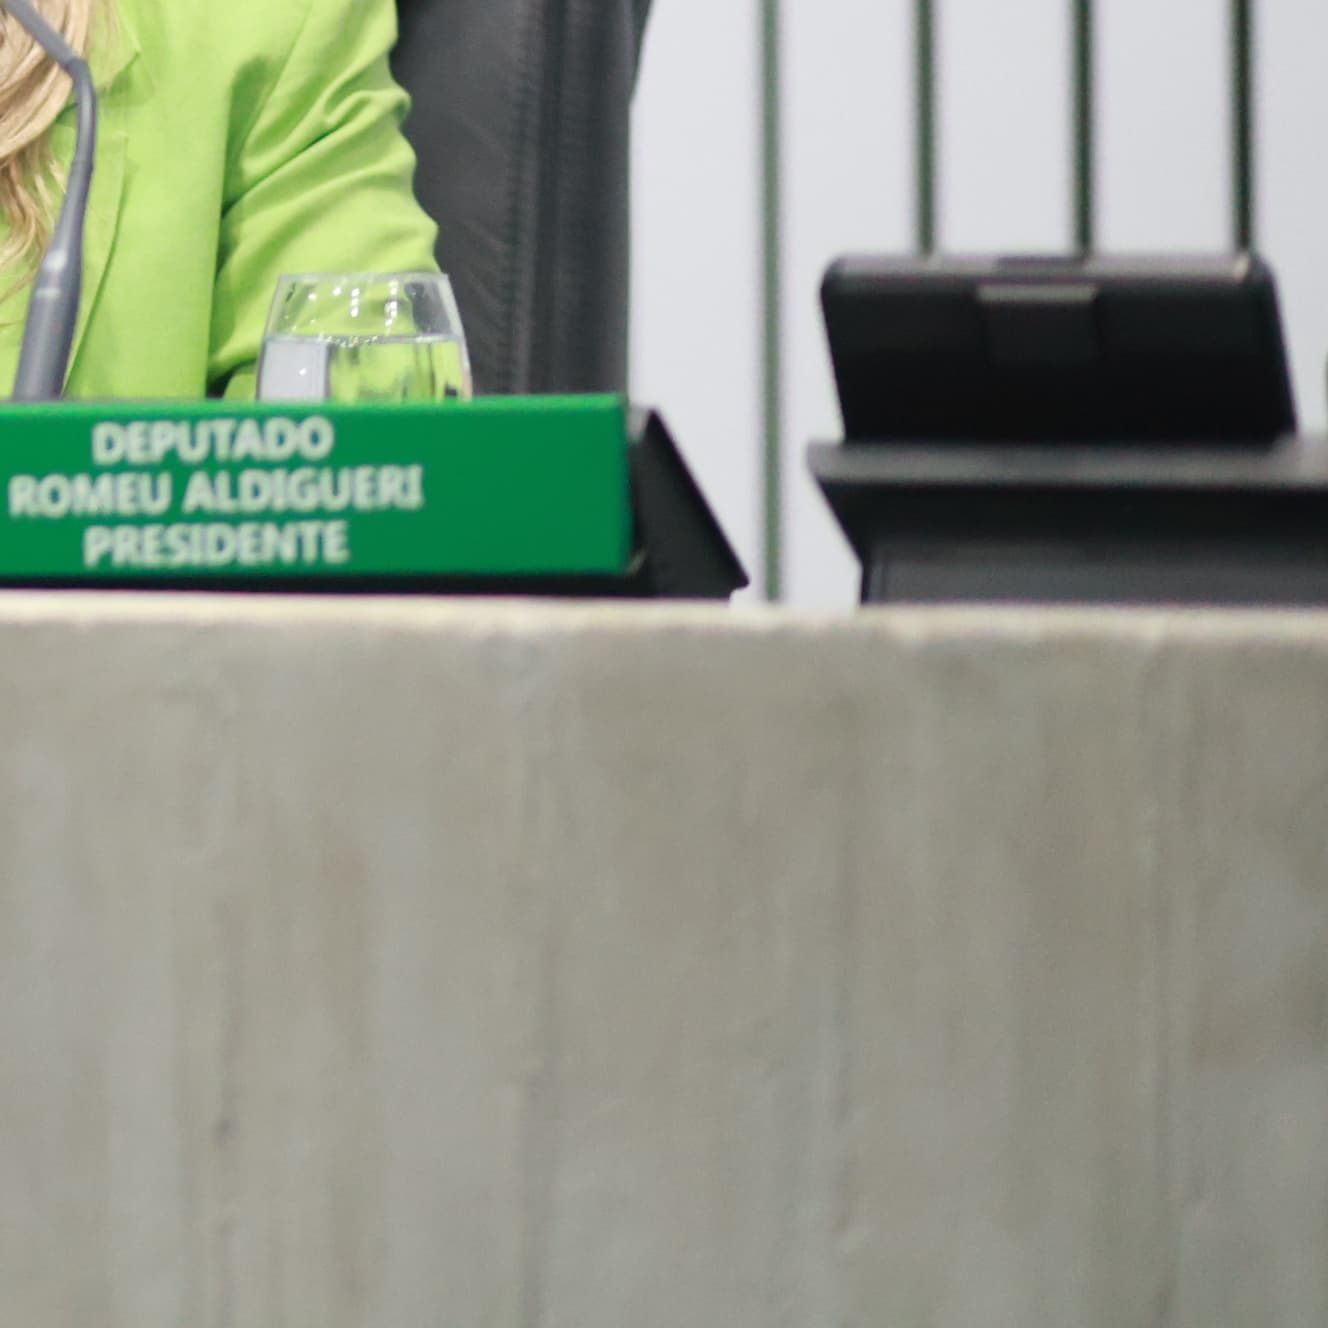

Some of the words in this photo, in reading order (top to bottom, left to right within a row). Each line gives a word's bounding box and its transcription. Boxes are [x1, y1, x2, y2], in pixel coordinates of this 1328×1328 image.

[93, 416, 333, 464] DEPUTADO
[10, 473, 171, 517] ROMEU
[184, 465, 422, 512] ALDIGUERI
[85, 522, 347, 566] PRESIDENTE
